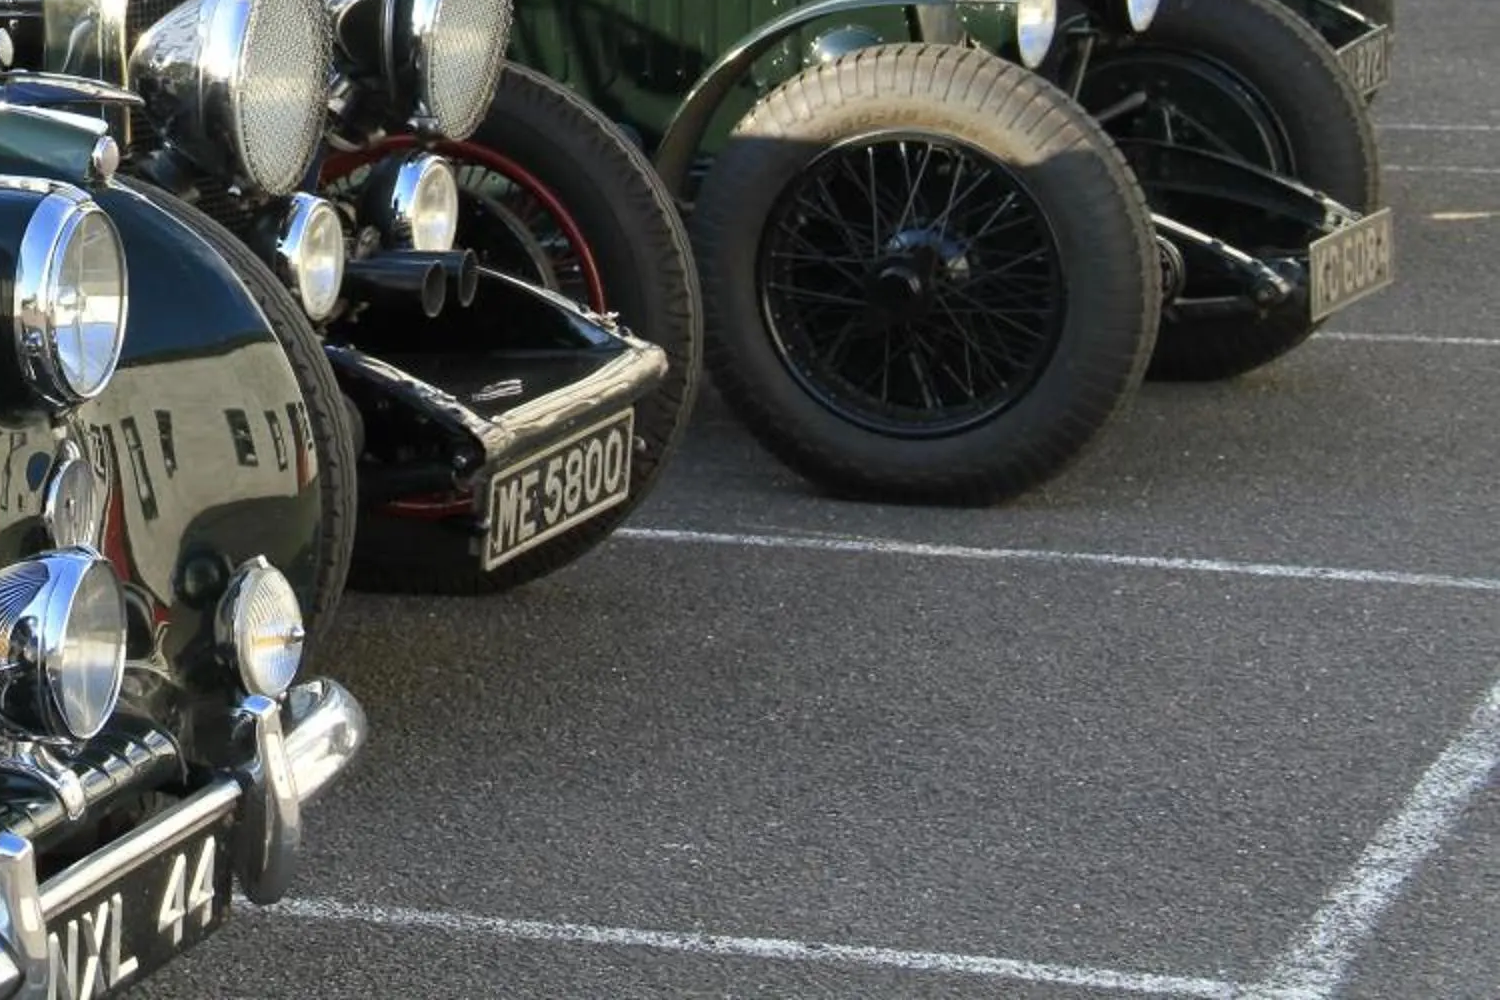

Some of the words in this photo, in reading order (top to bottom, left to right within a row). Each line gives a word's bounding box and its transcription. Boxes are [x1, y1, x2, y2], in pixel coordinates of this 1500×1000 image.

[496, 469, 540, 553] ME
[543, 428, 623, 525] 5800
[47, 892, 139, 1000] NXL
[157, 835, 216, 947] 44
